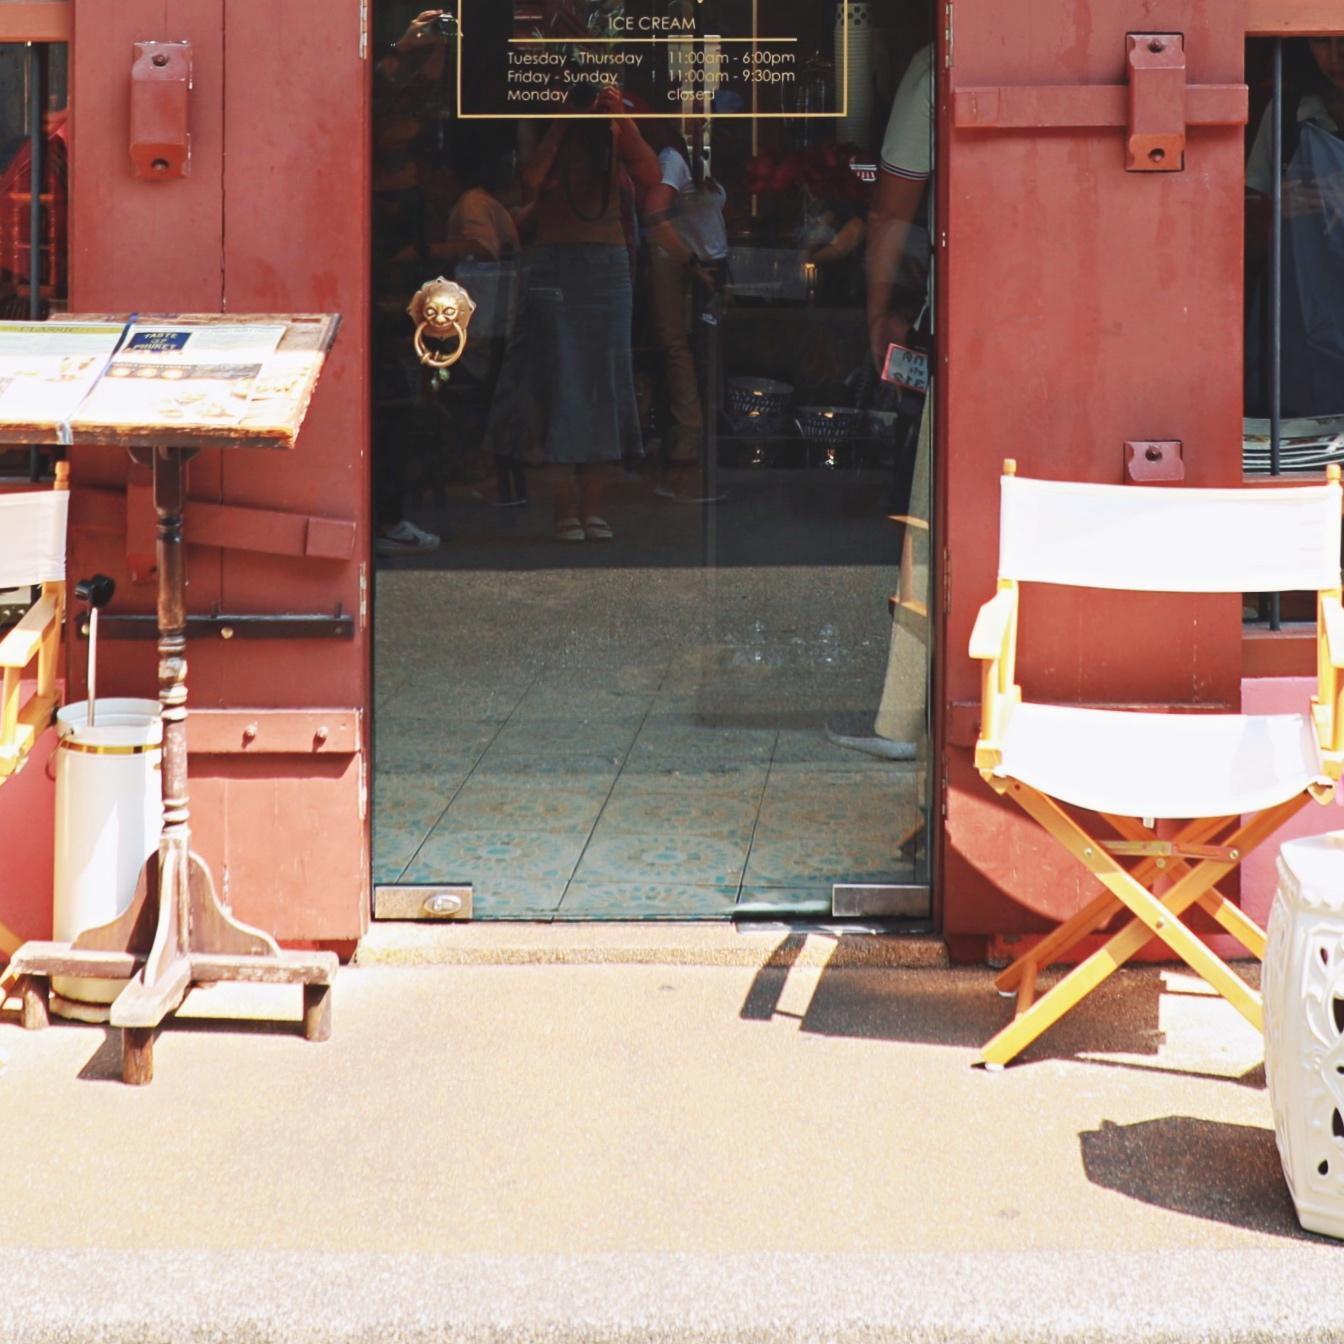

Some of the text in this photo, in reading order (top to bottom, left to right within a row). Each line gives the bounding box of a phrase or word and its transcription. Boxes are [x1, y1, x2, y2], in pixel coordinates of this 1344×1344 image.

[608, 17, 696, 31] ICE CREAM
[507, 52, 567, 67] Tuesday
[580, 51, 643, 67] Thursday
[669, 51, 729, 64] 11:00am
[742, 51, 796, 67] 6:00pm
[507, 69, 551, 85] Friday
[563, 69, 618, 85] Sunday
[669, 69, 729, 83] 11:00am
[742, 69, 796, 85] 9:30pm
[507, 87, 715, 103] Monday closed
